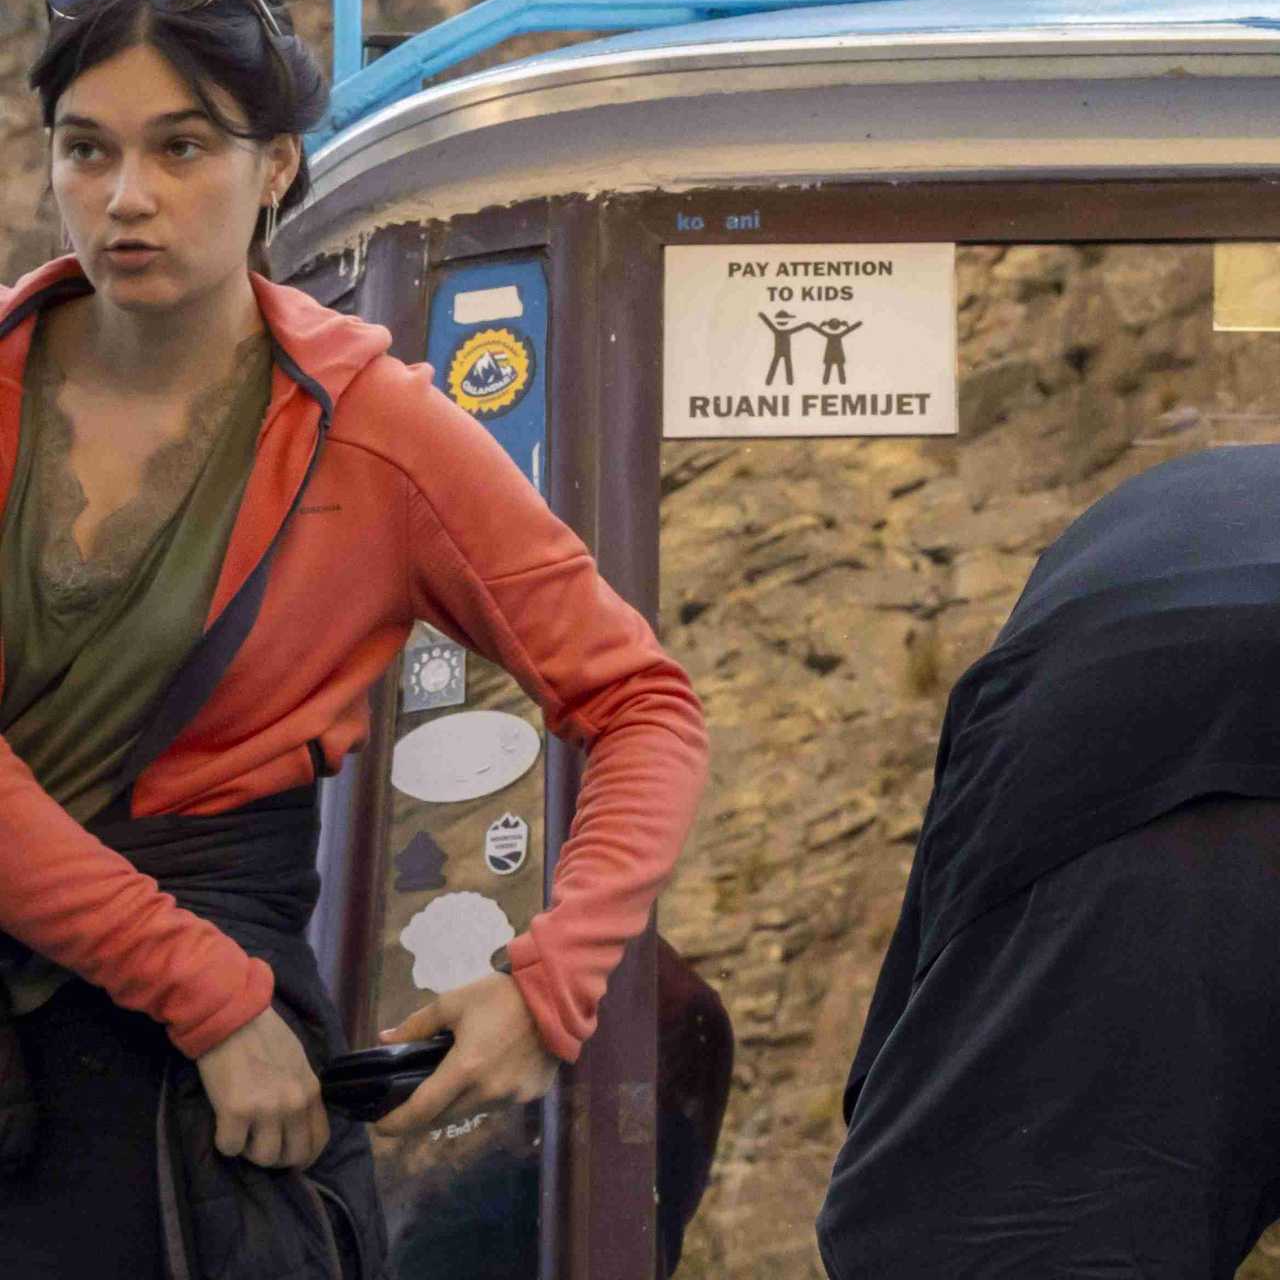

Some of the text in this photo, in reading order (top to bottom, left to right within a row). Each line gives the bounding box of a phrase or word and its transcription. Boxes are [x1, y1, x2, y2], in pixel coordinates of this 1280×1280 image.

[727, 261, 893, 278] PAY ATTENTION
[766, 286, 854, 302] TO KIDS
[689, 393, 931, 418] RUANI FEMIJET
